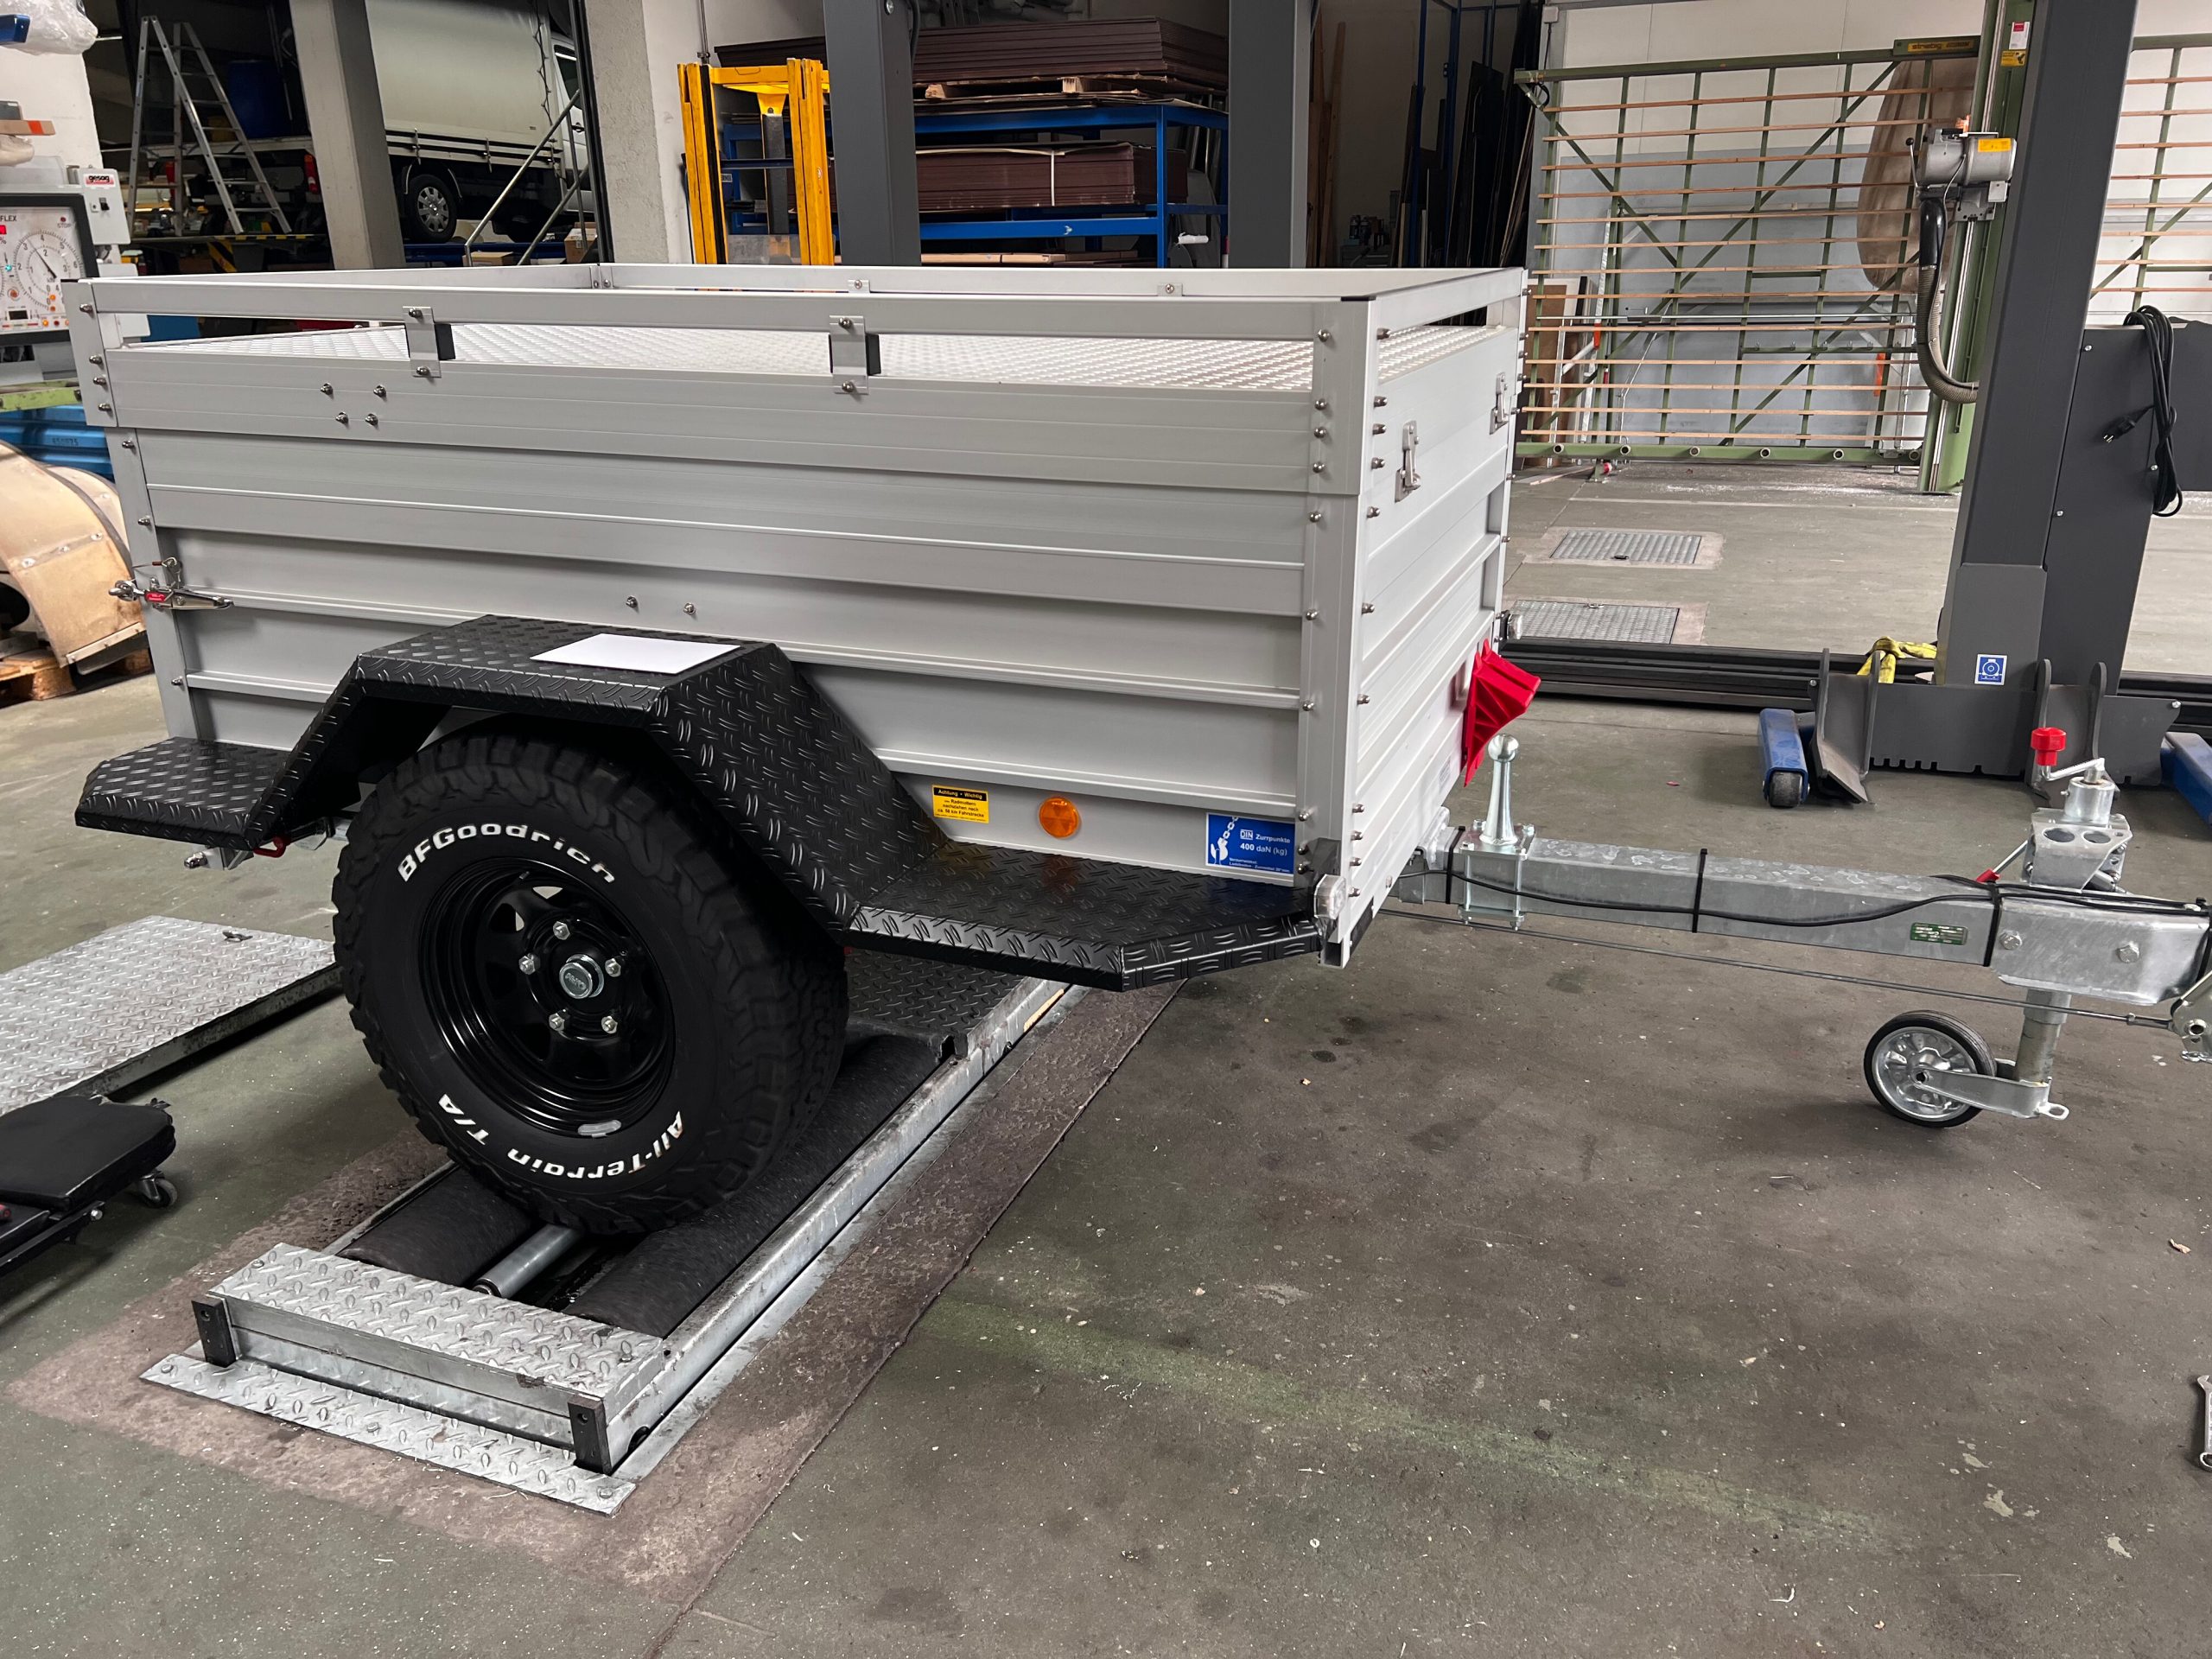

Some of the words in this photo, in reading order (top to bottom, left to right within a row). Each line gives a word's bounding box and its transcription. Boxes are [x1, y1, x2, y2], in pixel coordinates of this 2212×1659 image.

[398, 823, 615, 882] BFGoodrich
[1240, 830, 1253, 840] DIN
[1255, 834, 1291, 843] Zurrpunkte
[1240, 842, 1255, 851] 400
[438, 1094, 489, 1146] T/A
[507, 1111, 683, 1179] All-Terrain
